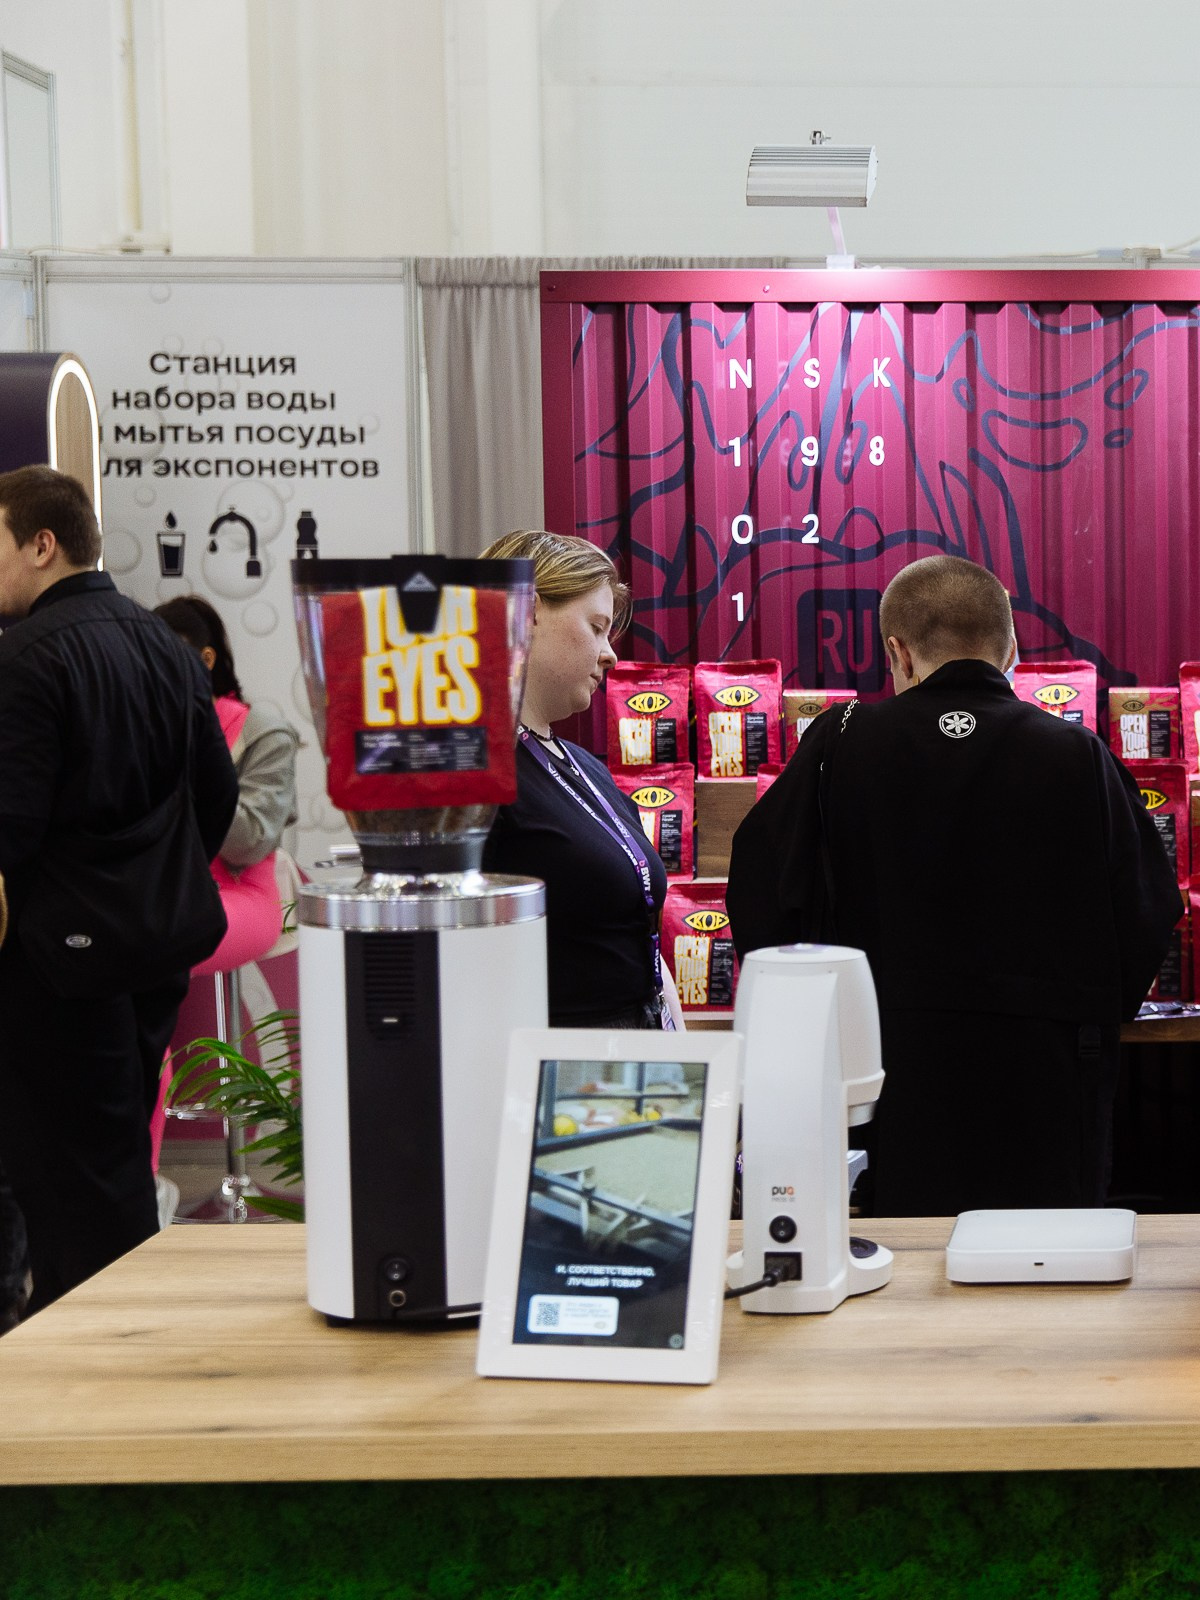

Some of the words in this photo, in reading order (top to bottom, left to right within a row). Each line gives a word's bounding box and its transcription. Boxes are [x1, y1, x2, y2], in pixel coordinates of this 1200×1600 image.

[150, 353, 296, 377] Станция
[729, 358, 753, 389] N
[803, 357, 821, 389] S
[873, 357, 892, 388] K
[112, 386, 235, 415] набора
[247, 392, 335, 414] воды
[114, 425, 223, 443] мытья
[235, 425, 365, 449] посуды
[728, 436, 742, 467] 1
[800, 435, 819, 467] 9
[868, 435, 885, 466] 8
[103, 458, 142, 477] ля
[153, 458, 379, 477] экспонентов
[801, 513, 820, 544] 2
[731, 592, 744, 622] 1
[817, 609, 873, 674] RU
[363, 634, 483, 727] EYES
[1120, 714, 1148, 734] OPEN
[1121, 730, 1149, 752] YOUR
[712, 753, 744, 777] EYES
[640, 867, 651, 891] BWT
[611, 1278, 643, 1289] ТОВАР
